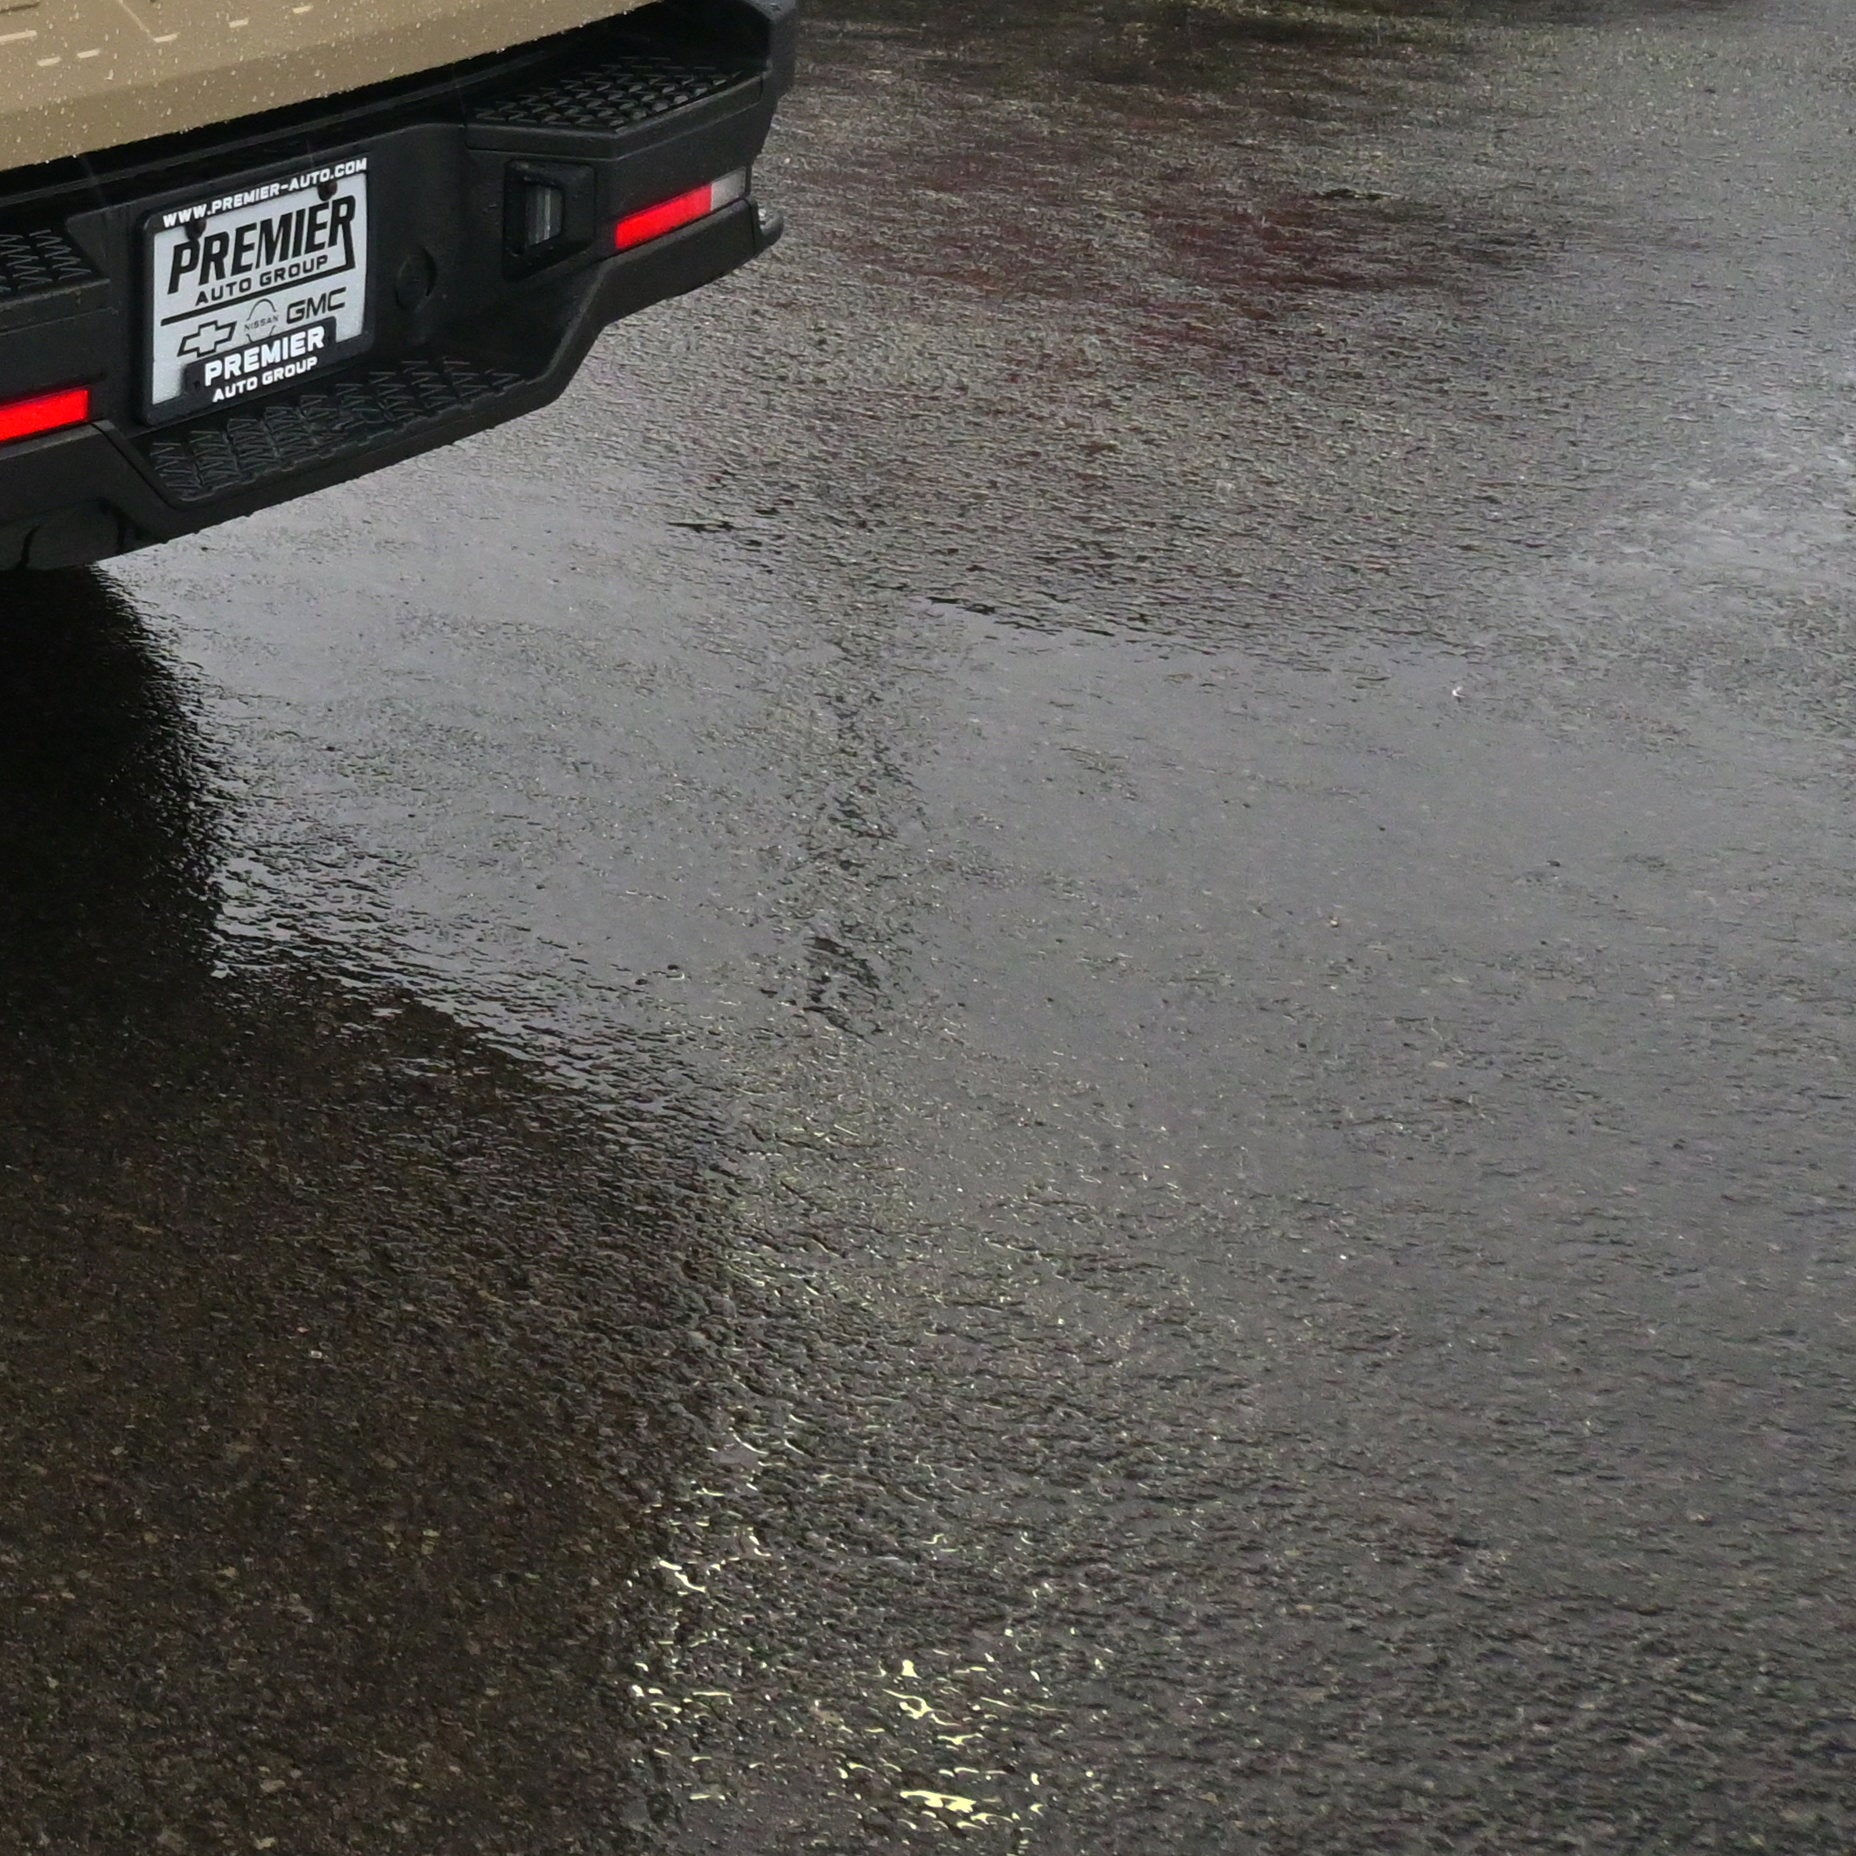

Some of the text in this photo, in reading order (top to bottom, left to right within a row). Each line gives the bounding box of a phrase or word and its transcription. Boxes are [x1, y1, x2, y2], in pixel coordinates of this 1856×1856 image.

[162, 158, 367, 228] WWW.PREMIER-AUTO.COM
[168, 195, 355, 294] PREMIER
[195, 254, 328, 306] AUTO GROUP
[286, 287, 346, 324] GMC
[243, 314, 279, 331] NISSAN
[205, 325, 325, 386] PREMIER
[212, 356, 318, 403] AUTO GROUP
